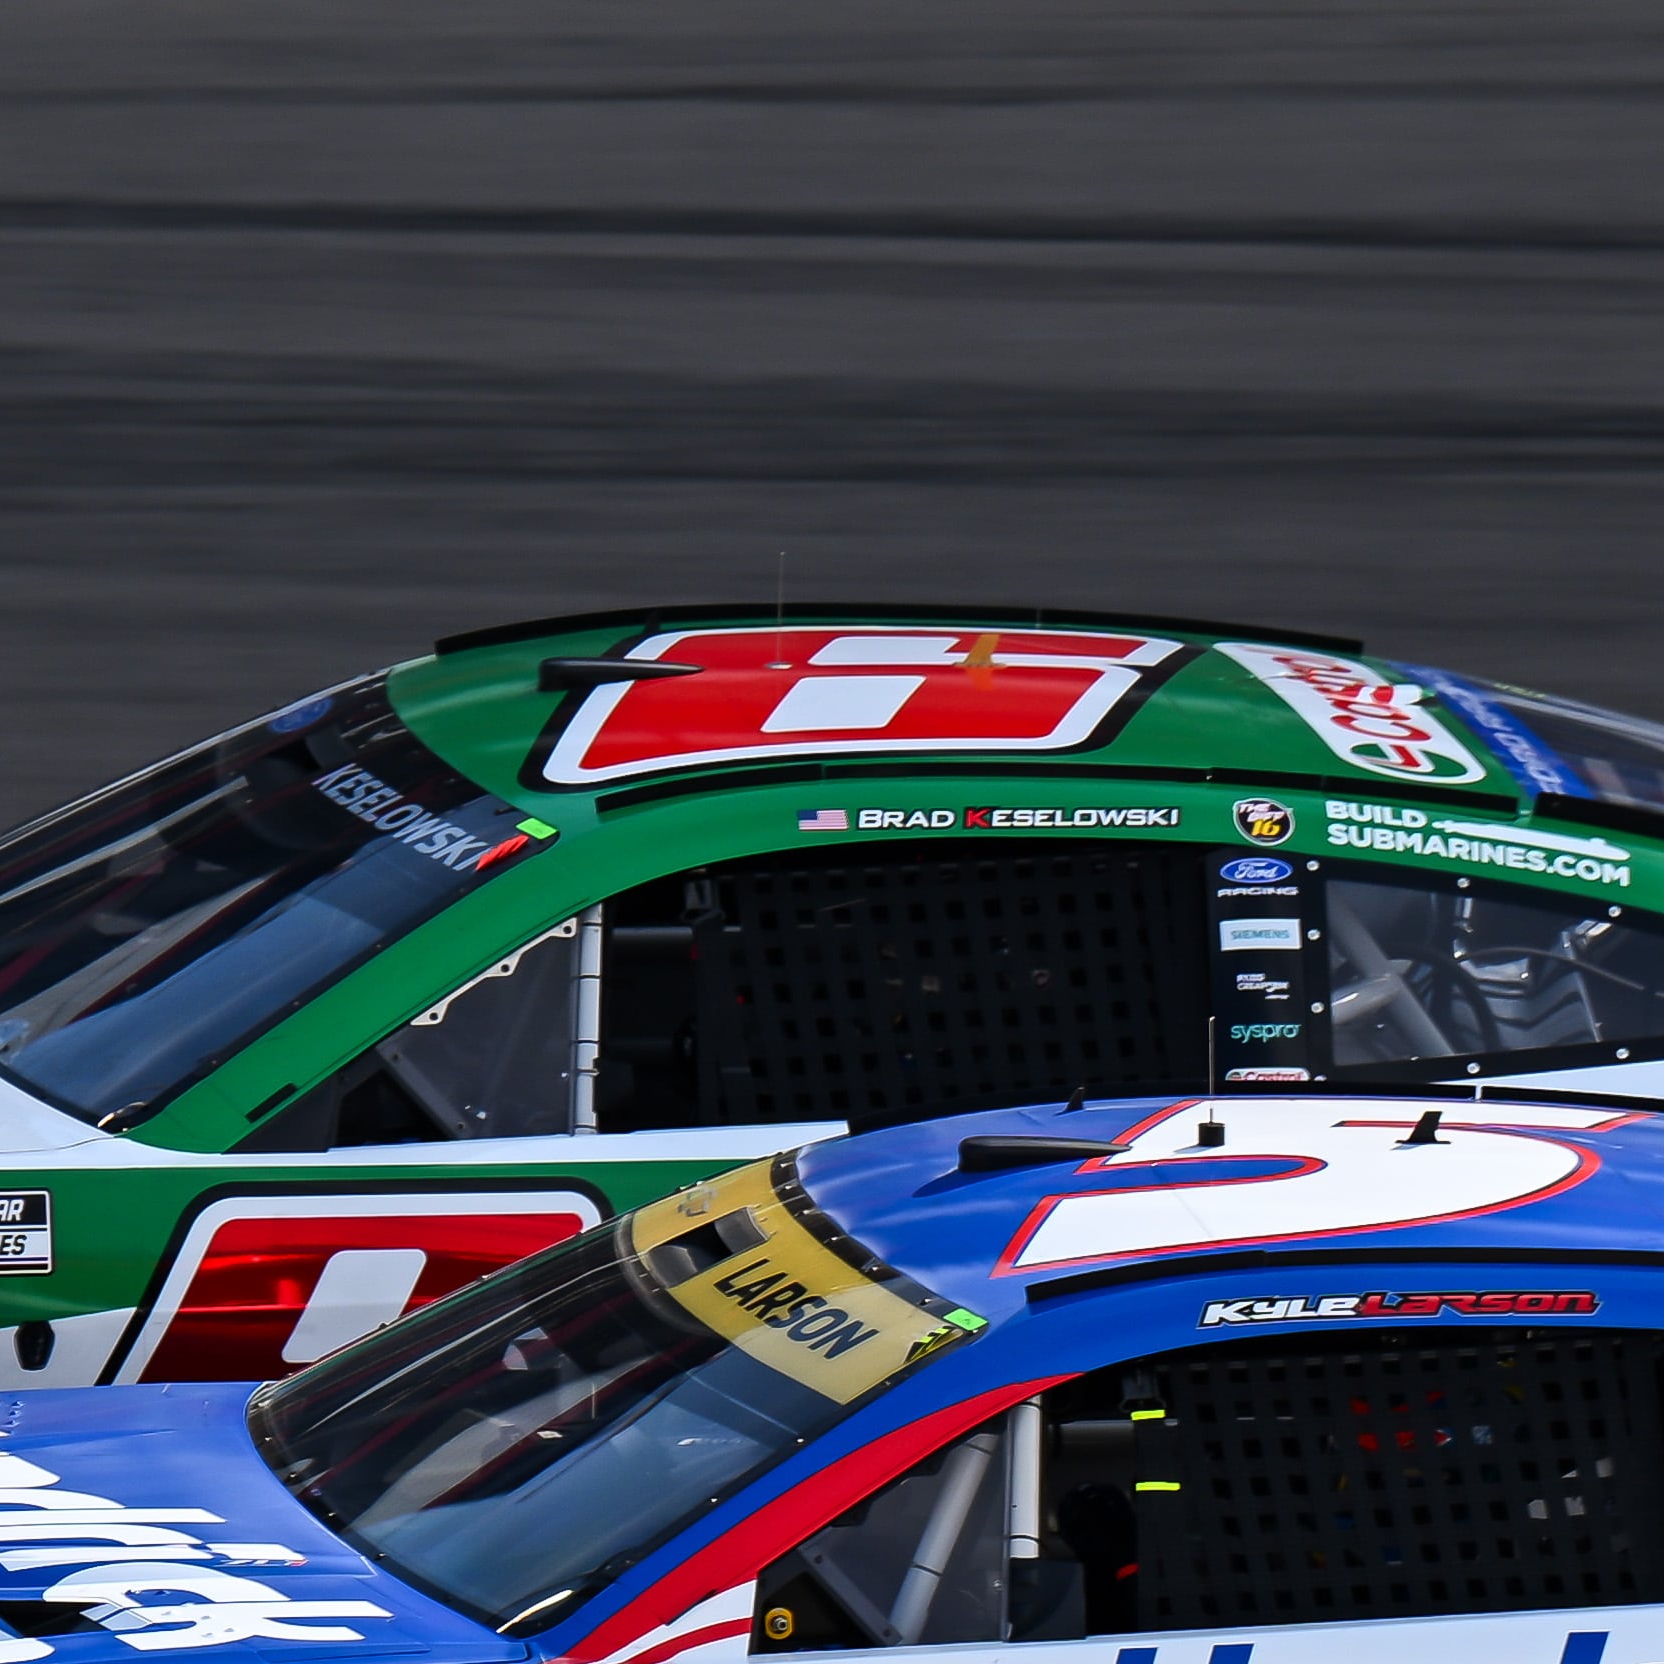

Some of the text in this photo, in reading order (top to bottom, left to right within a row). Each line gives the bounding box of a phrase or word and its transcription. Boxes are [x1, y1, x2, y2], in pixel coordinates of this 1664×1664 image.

[311, 763, 491, 871] KESELOWSKI
[858, 807, 1179, 828] BRAD KESELOWSKI
[1325, 800, 1427, 828] BUILD
[1251, 819, 1281, 836] 16
[1327, 823, 1630, 887] SUBMARINES.COM
[1234, 861, 1279, 879] Ford
[1217, 886, 1298, 897] RACING
[1231, 929, 1289, 940] SIEMENS
[1230, 1023, 1302, 1043] syspro
[989, 1098, 1657, 1280] 5
[712, 1259, 880, 1360] LARSON
